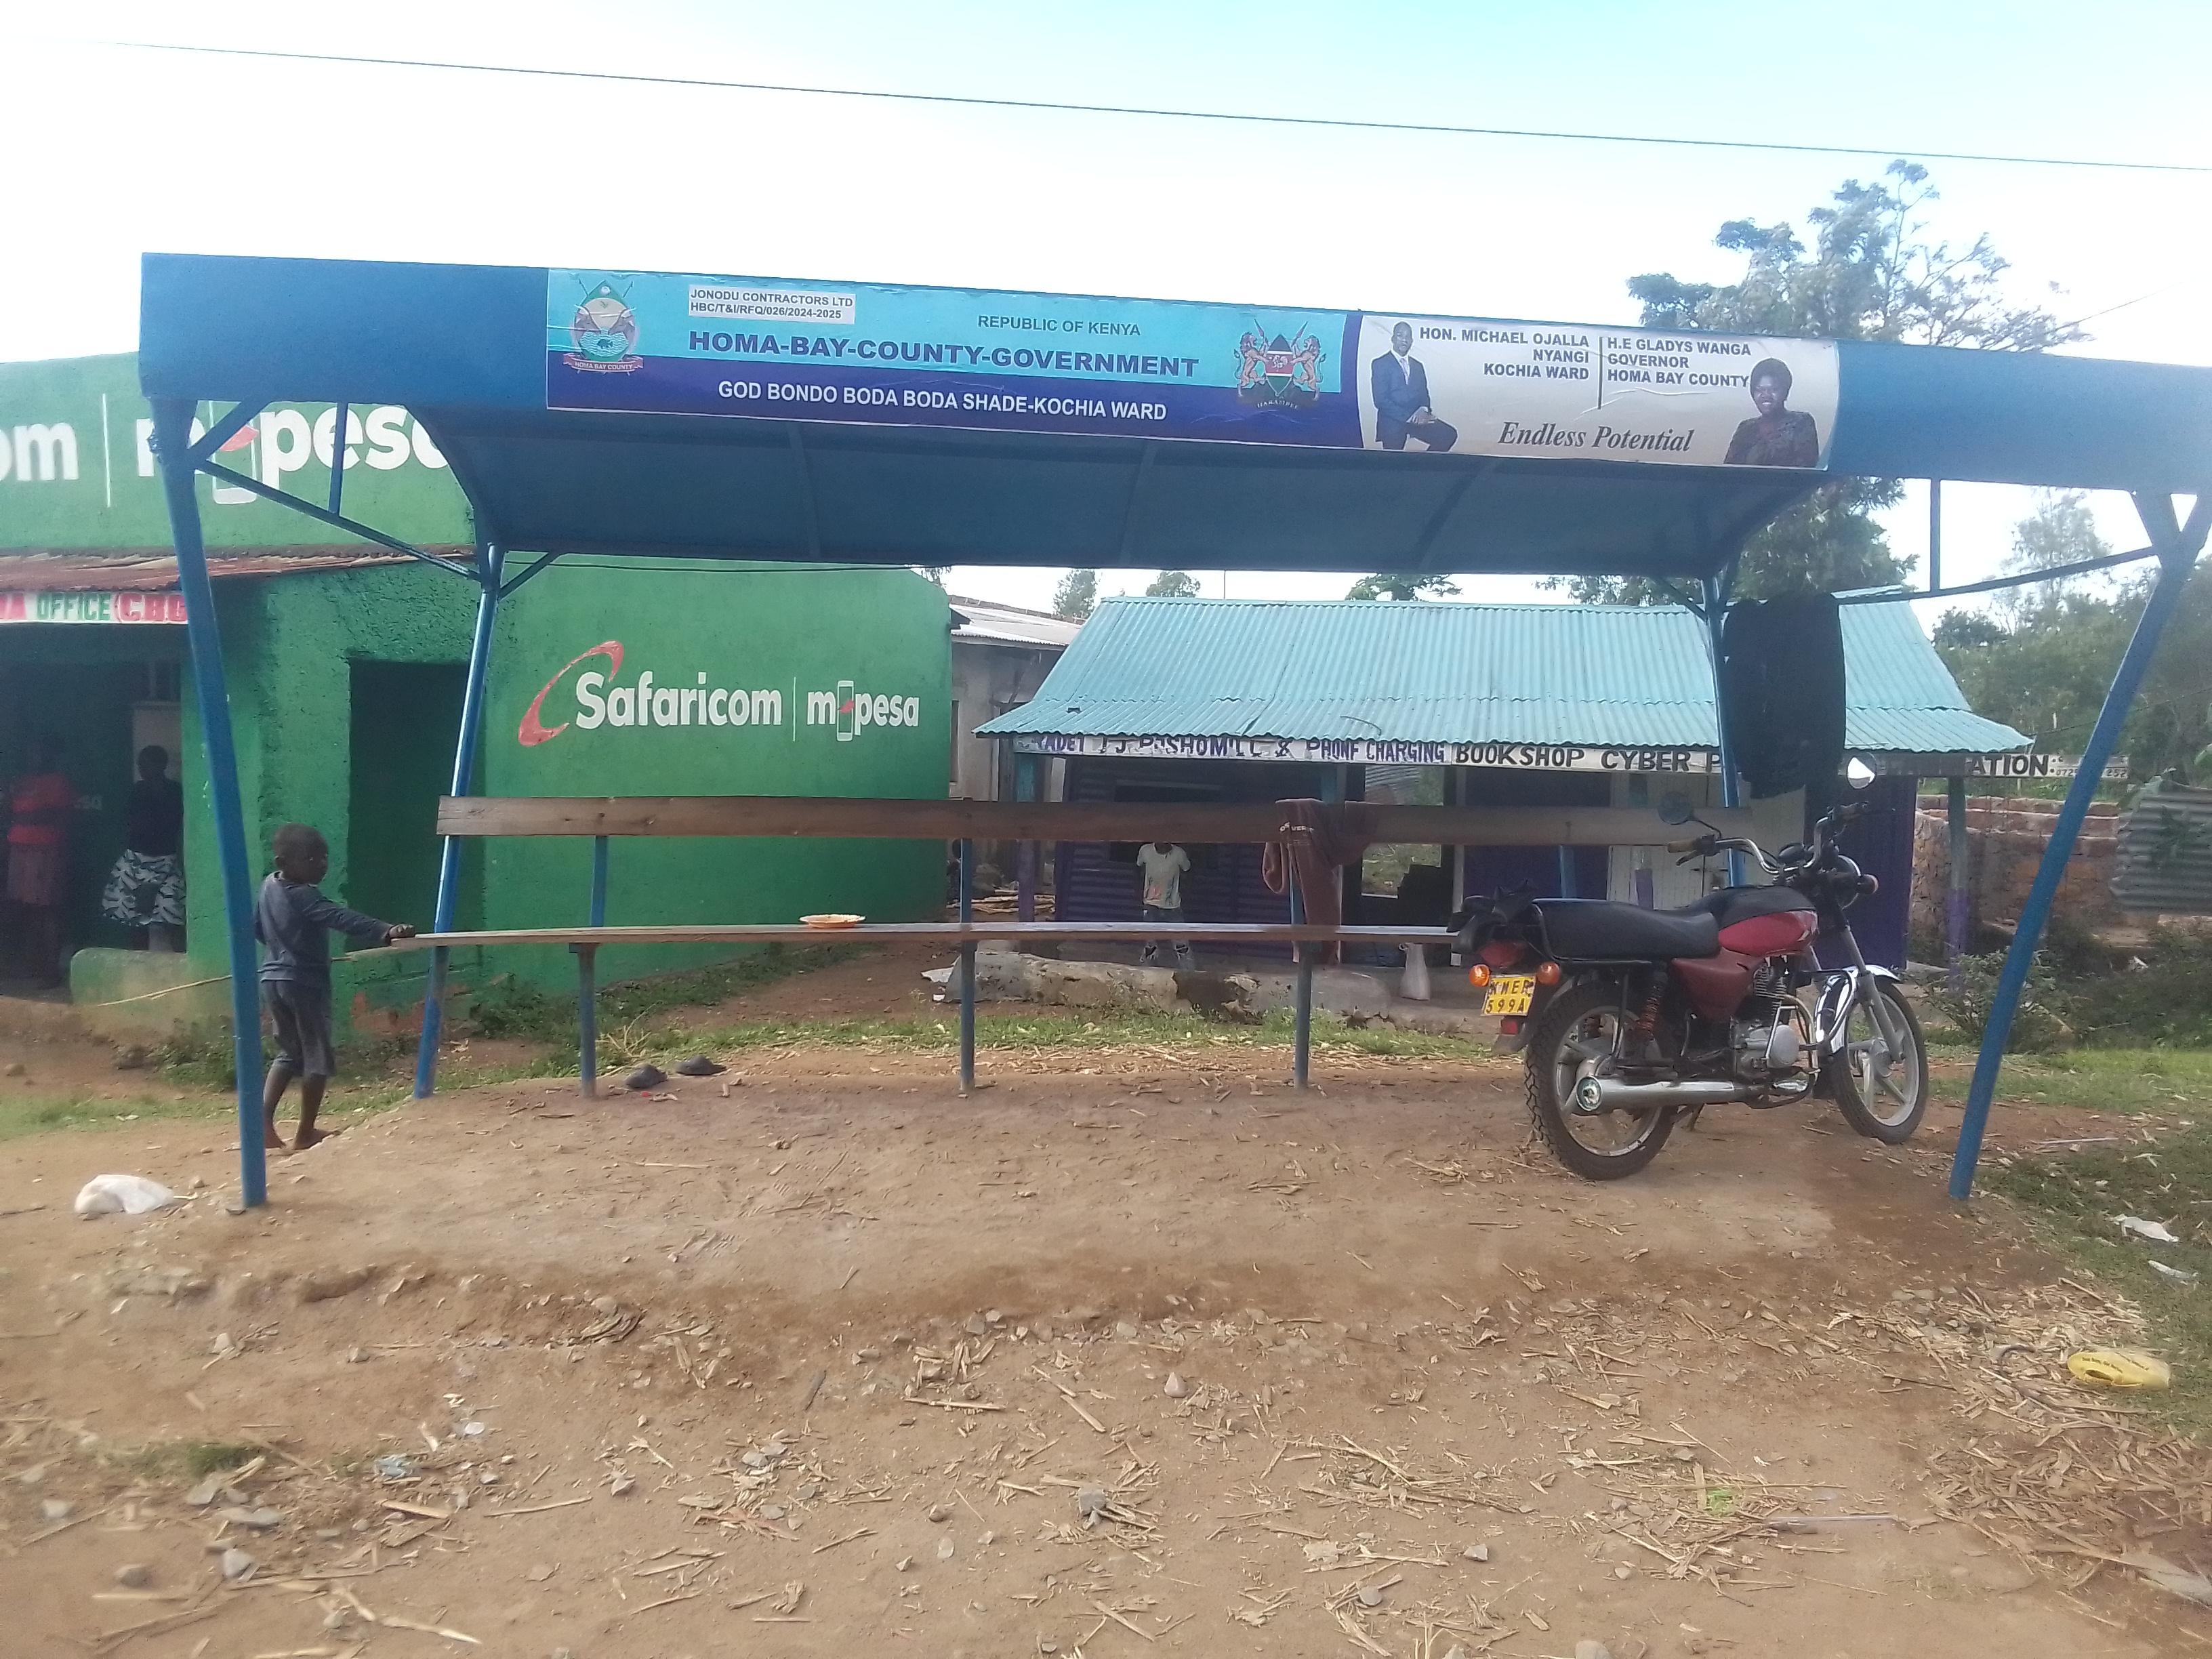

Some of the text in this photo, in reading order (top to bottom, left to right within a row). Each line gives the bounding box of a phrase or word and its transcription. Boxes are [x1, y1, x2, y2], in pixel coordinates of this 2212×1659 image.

[691, 289, 853, 307] JONODU CONTRACTORS LTD
[691, 302, 842, 319] HBC/T&I/RFQ/026/2024-2025
[978, 315, 1141, 336] REPUBLIC OF KENYA
[1420, 327, 1589, 347] HON. MICHAEL OJALLA
[1607, 337, 1751, 355] H.E GLADYS WANGA
[689, 331, 1199, 377] HOMA-BAY-COUNTY-GOVERNMENT
[1533, 349, 1589, 363] NYANGI
[1607, 353, 1689, 369] GOVERNOR
[1483, 363, 1589, 380] KOCHIA WARD
[1607, 369, 1749, 387] HOMA BAY COUNTY
[718, 381, 1166, 420] GOD BONDO BODA BODA SHADE-KOCHIA WARD
[1498, 421, 1695, 452] Endless Potential
[37, 592, 110, 620] OFFICE
[576, 671, 782, 730] Safaricom
[1366, 741, 1444, 763] CHARGING
[1456, 745, 1584, 767] BOOKSHOP
[1601, 750, 1691, 772] CYBER
[1486, 998, 1525, 1014] 599A
